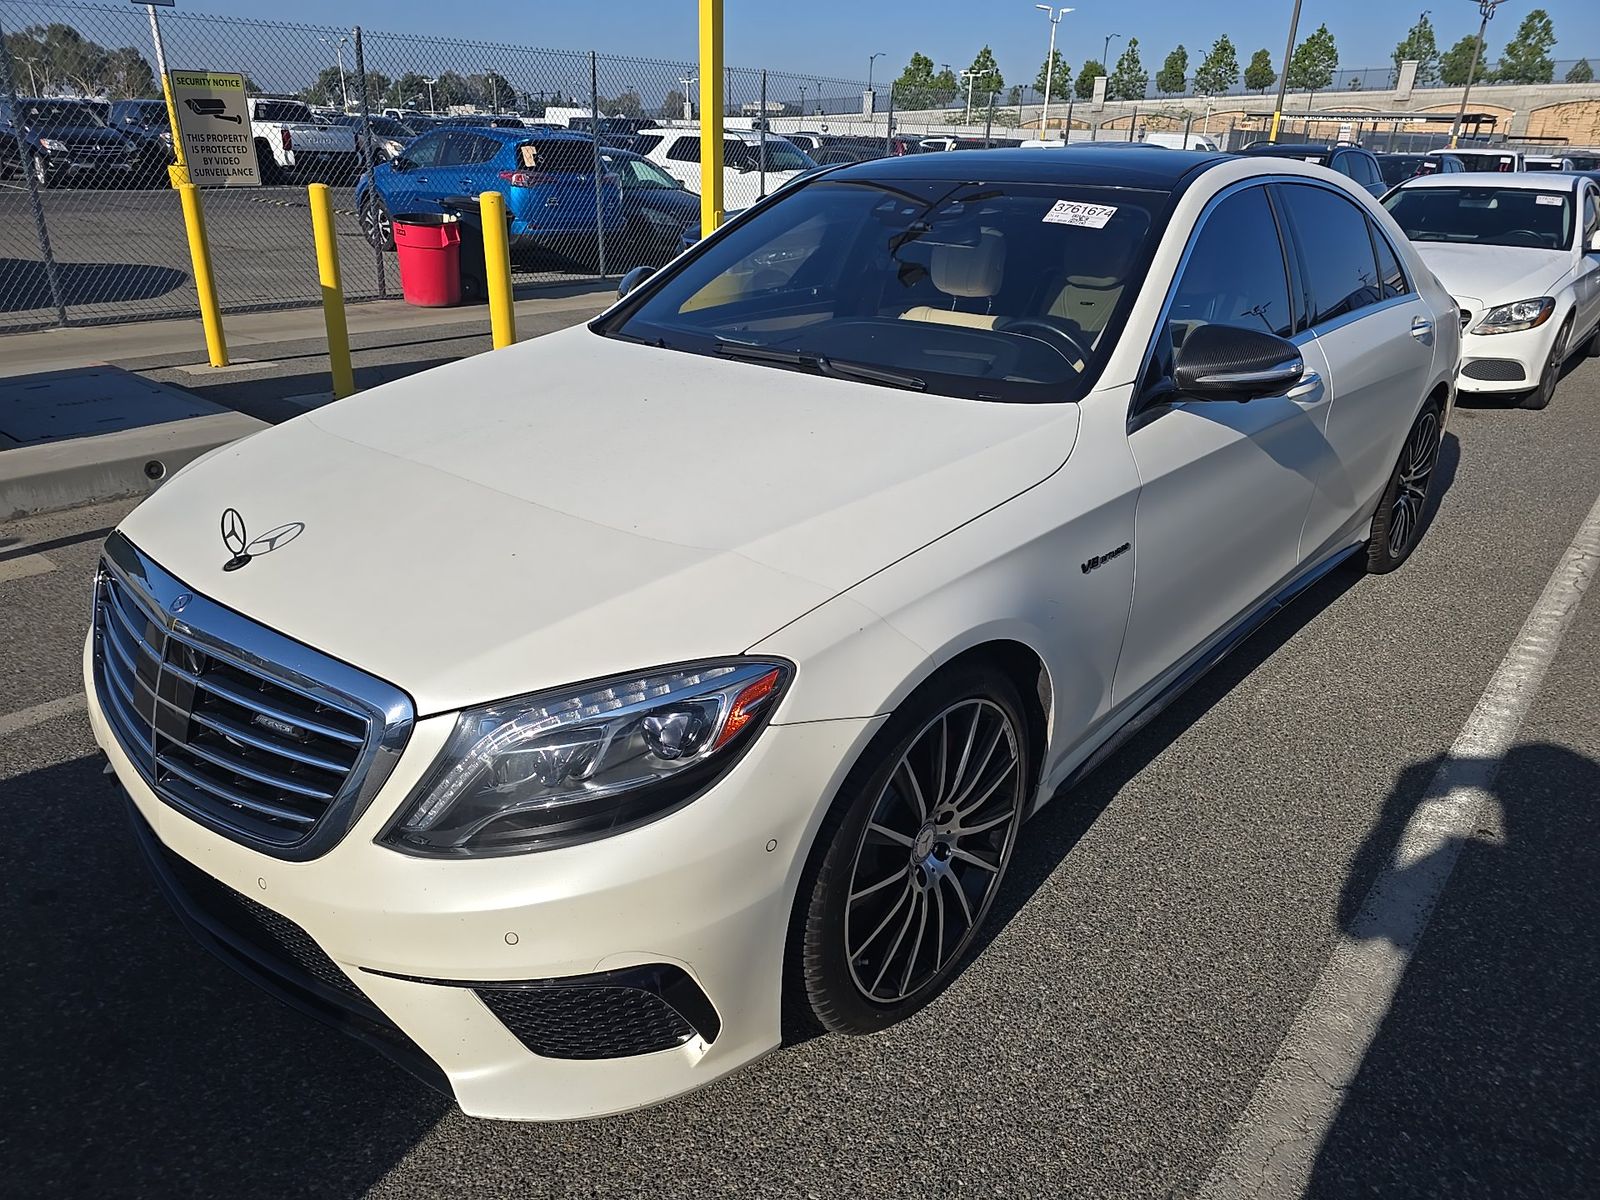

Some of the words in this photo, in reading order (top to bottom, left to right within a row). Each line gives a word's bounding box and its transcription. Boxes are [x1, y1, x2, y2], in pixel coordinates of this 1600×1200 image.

[176, 77, 211, 86] SECURITY
[213, 79, 240, 87] NOTICE
[187, 134, 206, 143] THIS
[207, 134, 248, 143] PROPERTY
[192, 146, 201, 154] IS
[201, 146, 248, 154] PROTECTED
[203, 157, 215, 165] BY
[215, 157, 240, 165] VIDEO
[194, 168, 254, 177] SURVEILLANCE
[1054, 203, 1114, 218] 3761674
[1081, 556, 1100, 574] V8
